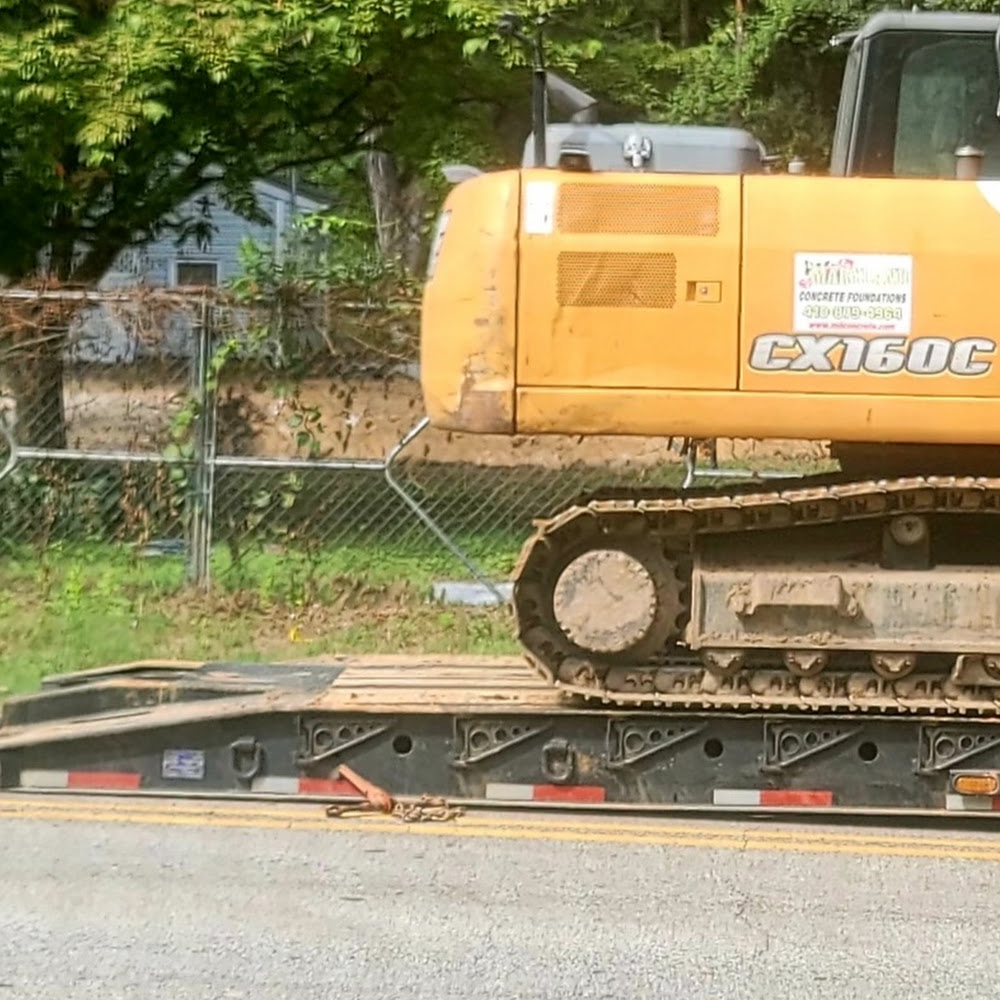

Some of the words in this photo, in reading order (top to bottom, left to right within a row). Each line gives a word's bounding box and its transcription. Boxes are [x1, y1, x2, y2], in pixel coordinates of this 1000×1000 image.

[799, 290, 845, 303] CONCRETE
[847, 292, 907, 305] FOUNDATIONS
[748, 332, 997, 376] CX160C
